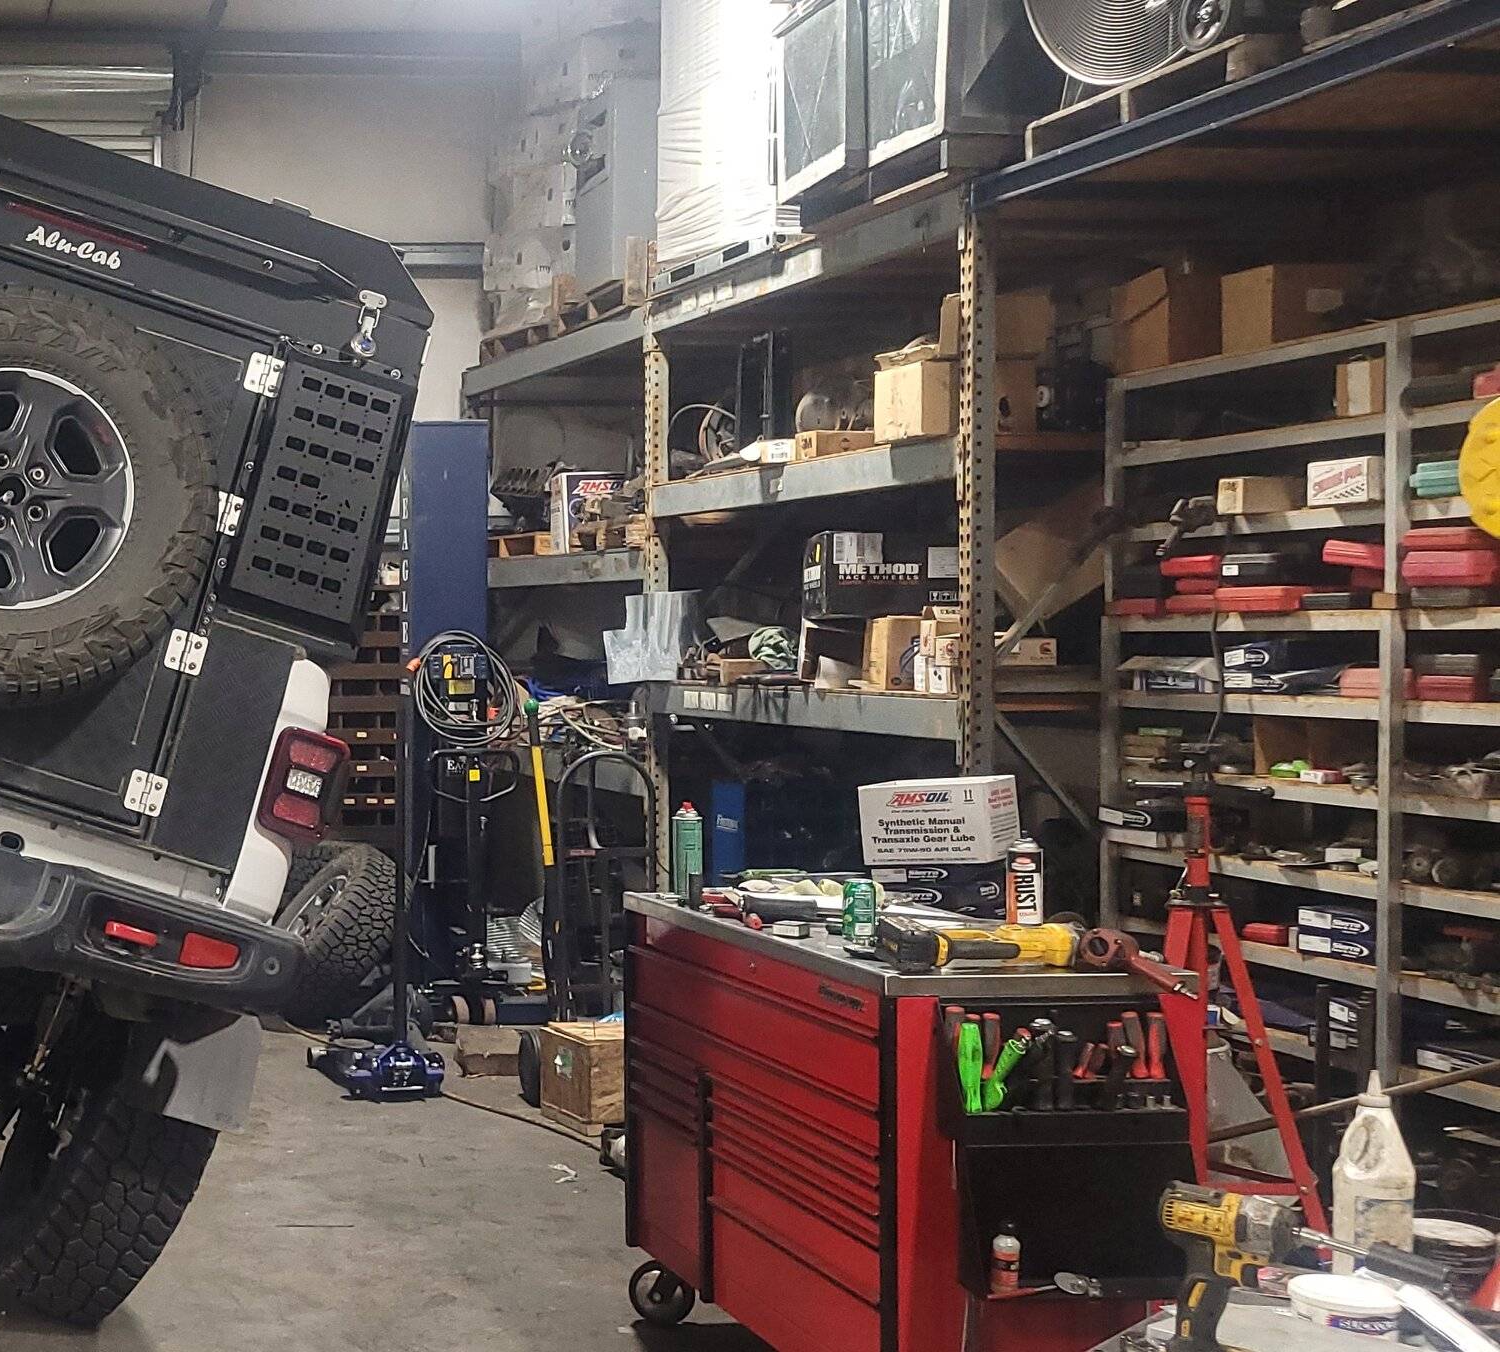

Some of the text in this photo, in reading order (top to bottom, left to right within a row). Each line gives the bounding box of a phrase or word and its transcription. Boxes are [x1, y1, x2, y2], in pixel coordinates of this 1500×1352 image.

[25, 225, 122, 270] Alu-Cab
[577, 481, 623, 493] AMSO
[838, 563, 920, 575] METHOD
[873, 573, 920, 581] WHEELS
[890, 791, 950, 805] AMSOIL
[878, 816, 966, 828] Synthetic Manual
[884, 826, 961, 836] Transmission &
[872, 834, 976, 845] Transaxle Gear Lube
[1013, 874, 1038, 912] RUST
